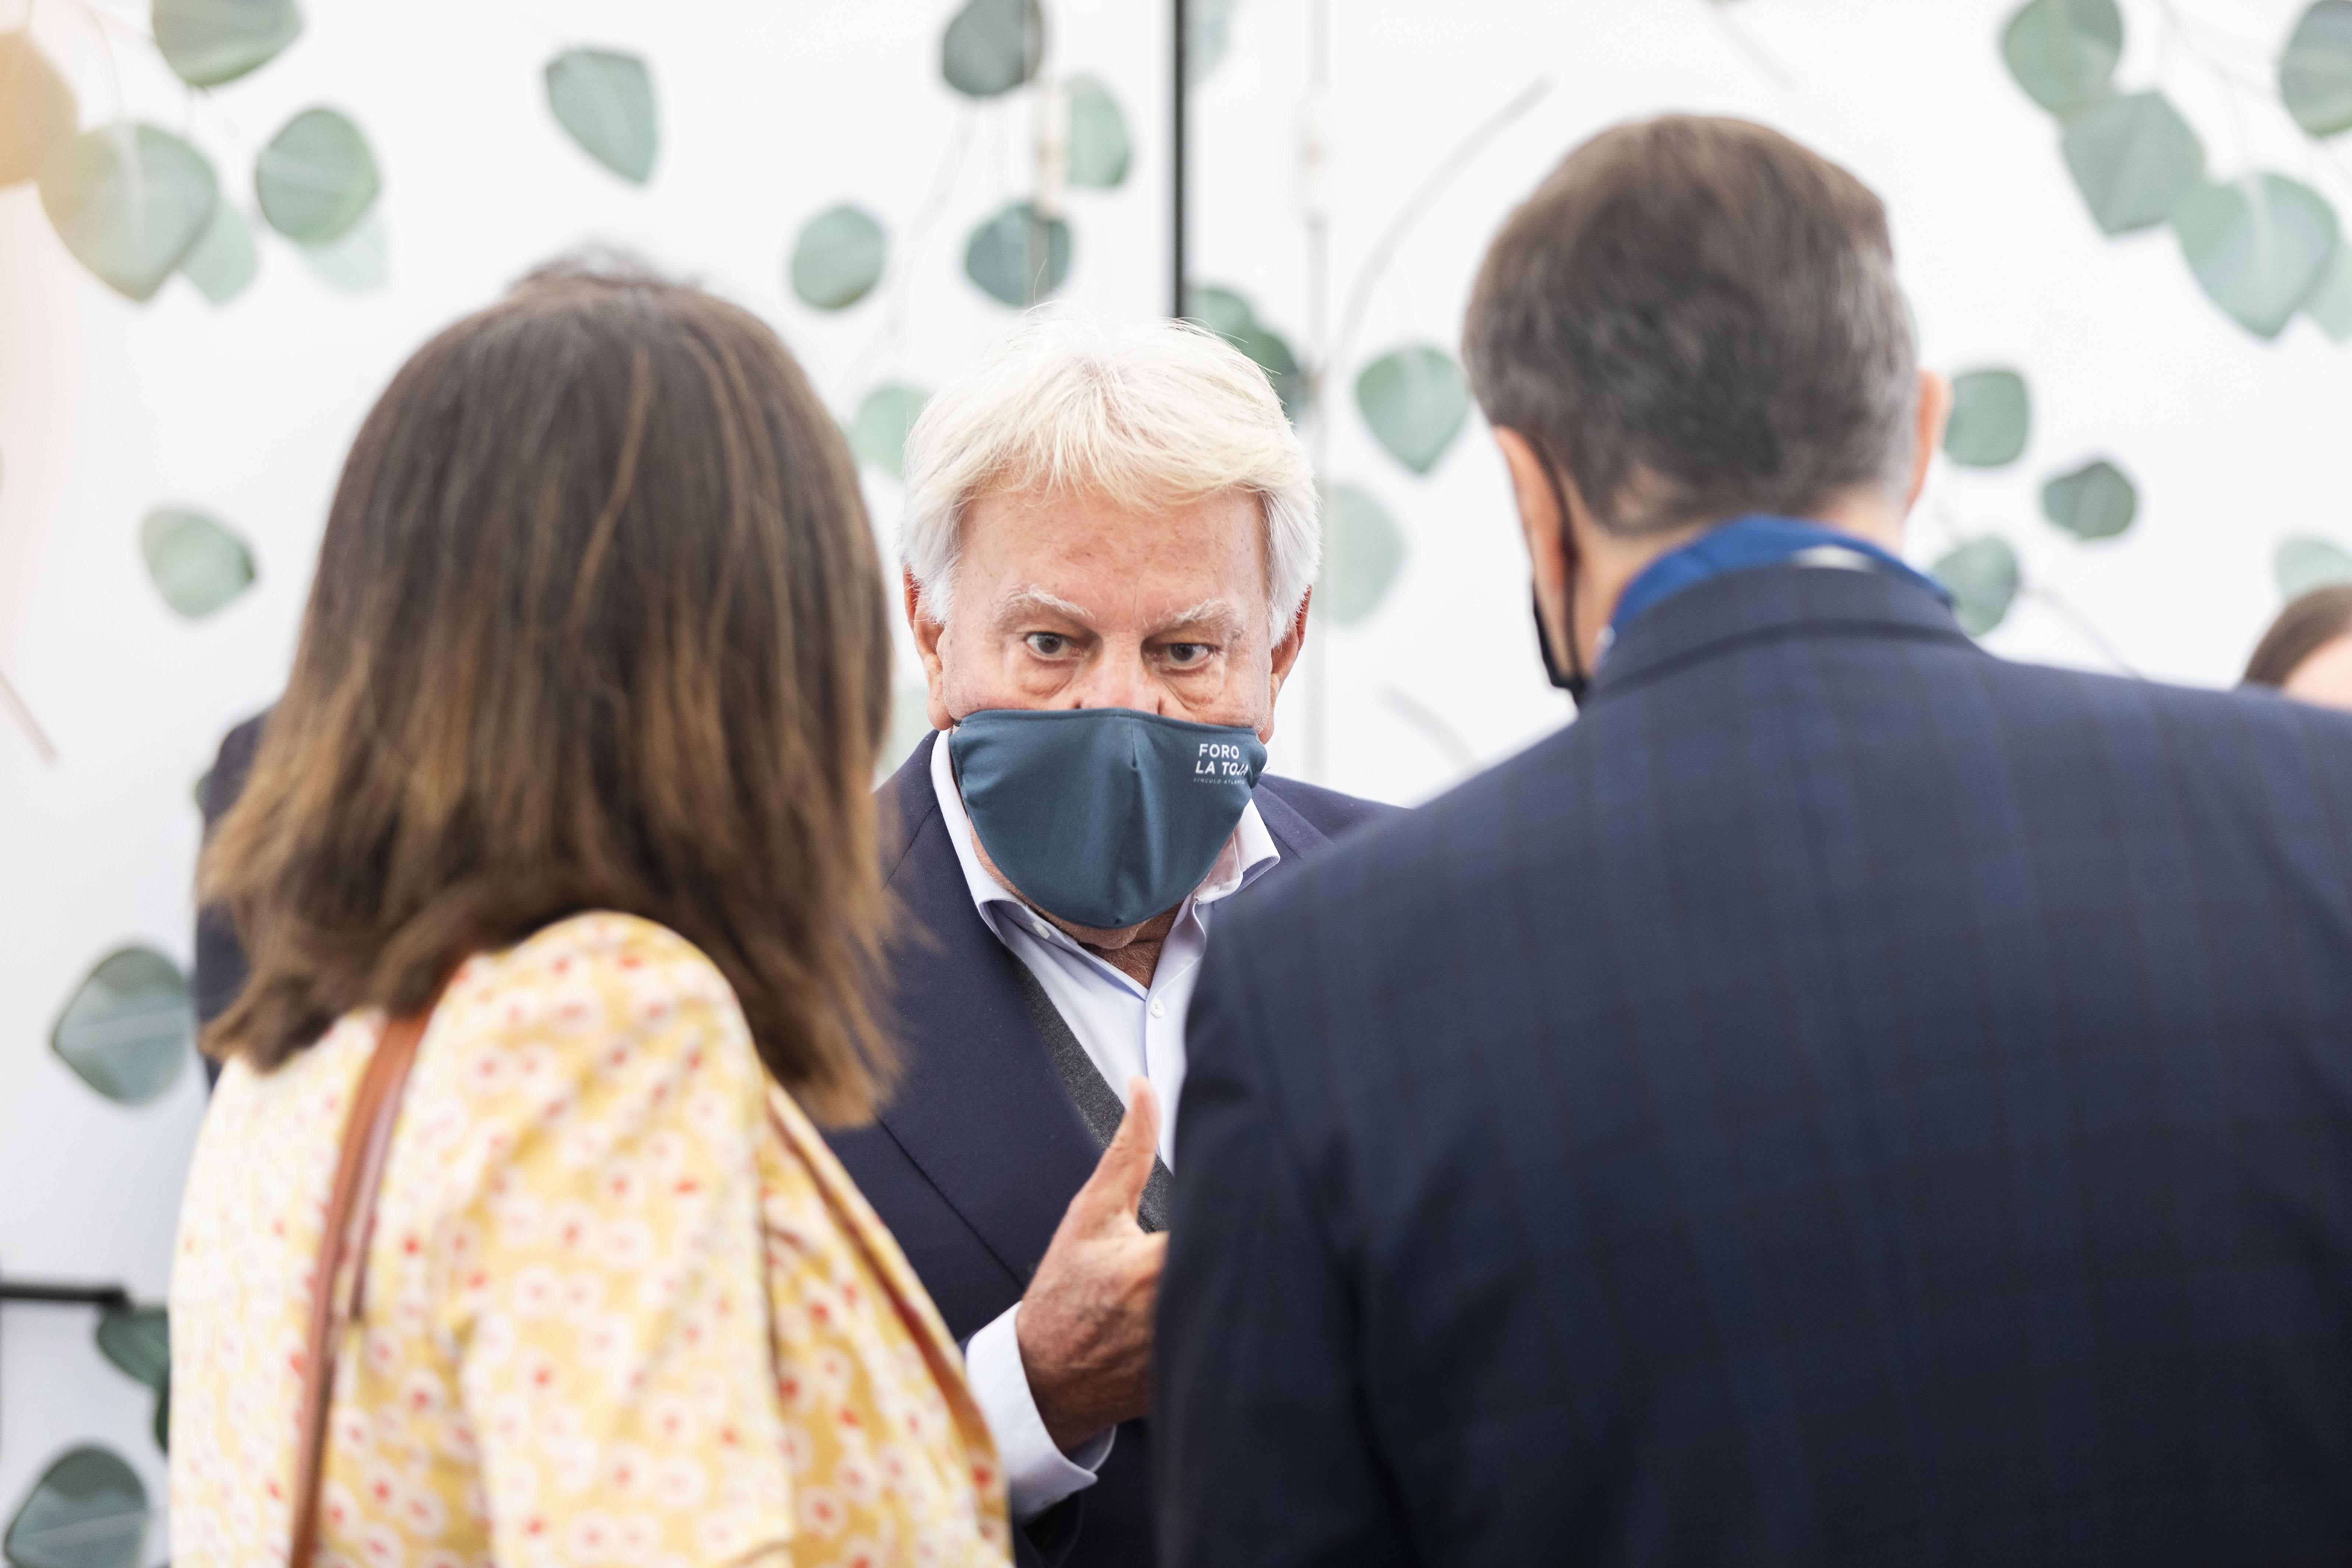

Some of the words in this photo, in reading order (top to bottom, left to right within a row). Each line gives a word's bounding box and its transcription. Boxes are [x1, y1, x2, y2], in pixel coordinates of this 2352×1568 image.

[1199, 744, 1239, 759] FORO
[1195, 760, 1215, 774] LA
[1222, 762, 1249, 776] TOJA
